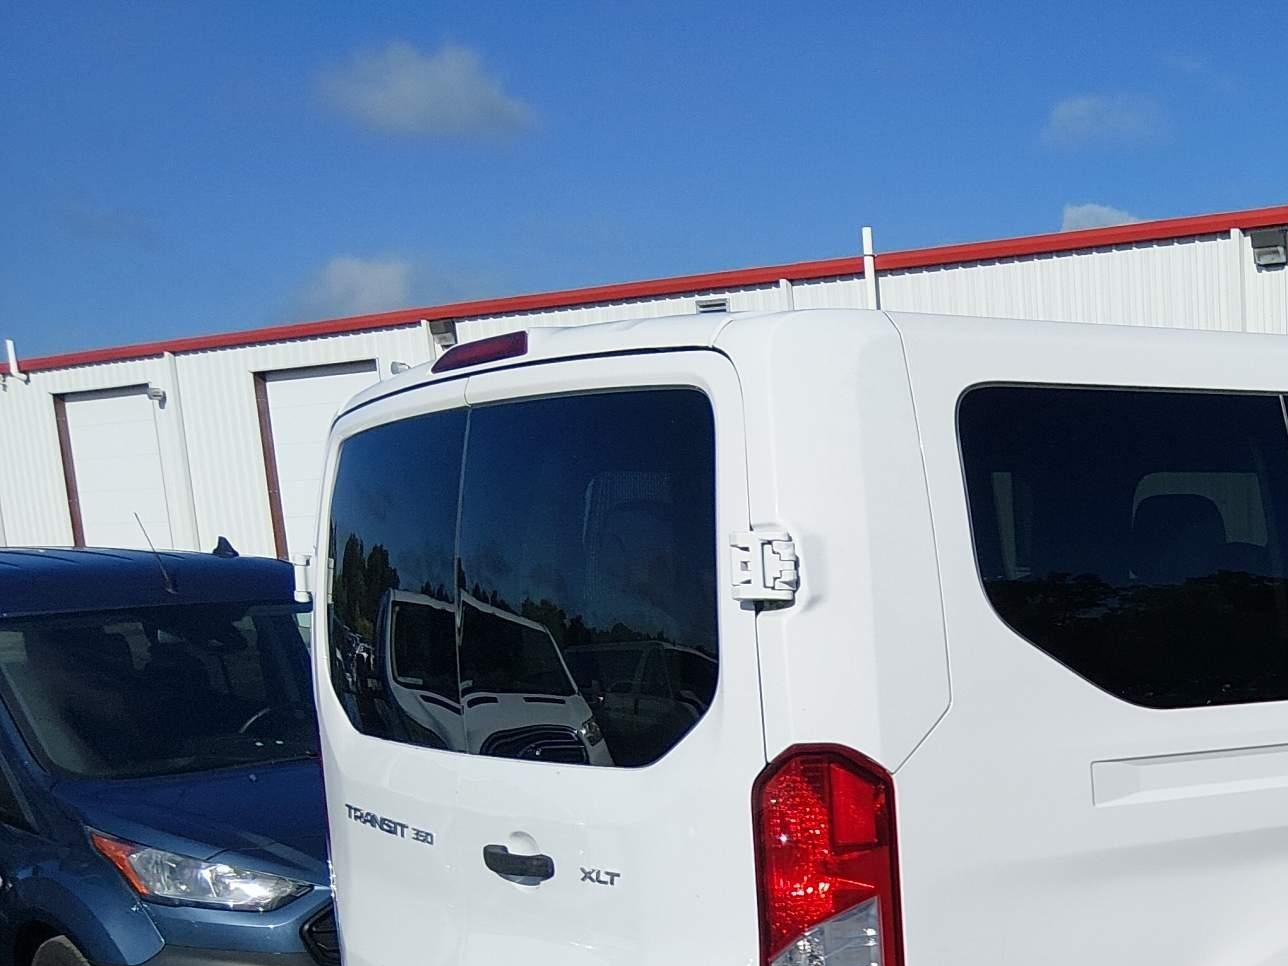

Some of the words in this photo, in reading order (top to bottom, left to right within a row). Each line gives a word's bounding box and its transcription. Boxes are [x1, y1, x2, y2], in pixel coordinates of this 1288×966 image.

[345, 803, 409, 838] TRANSIT
[411, 826, 435, 846] 350
[580, 867, 621, 886] XLT
